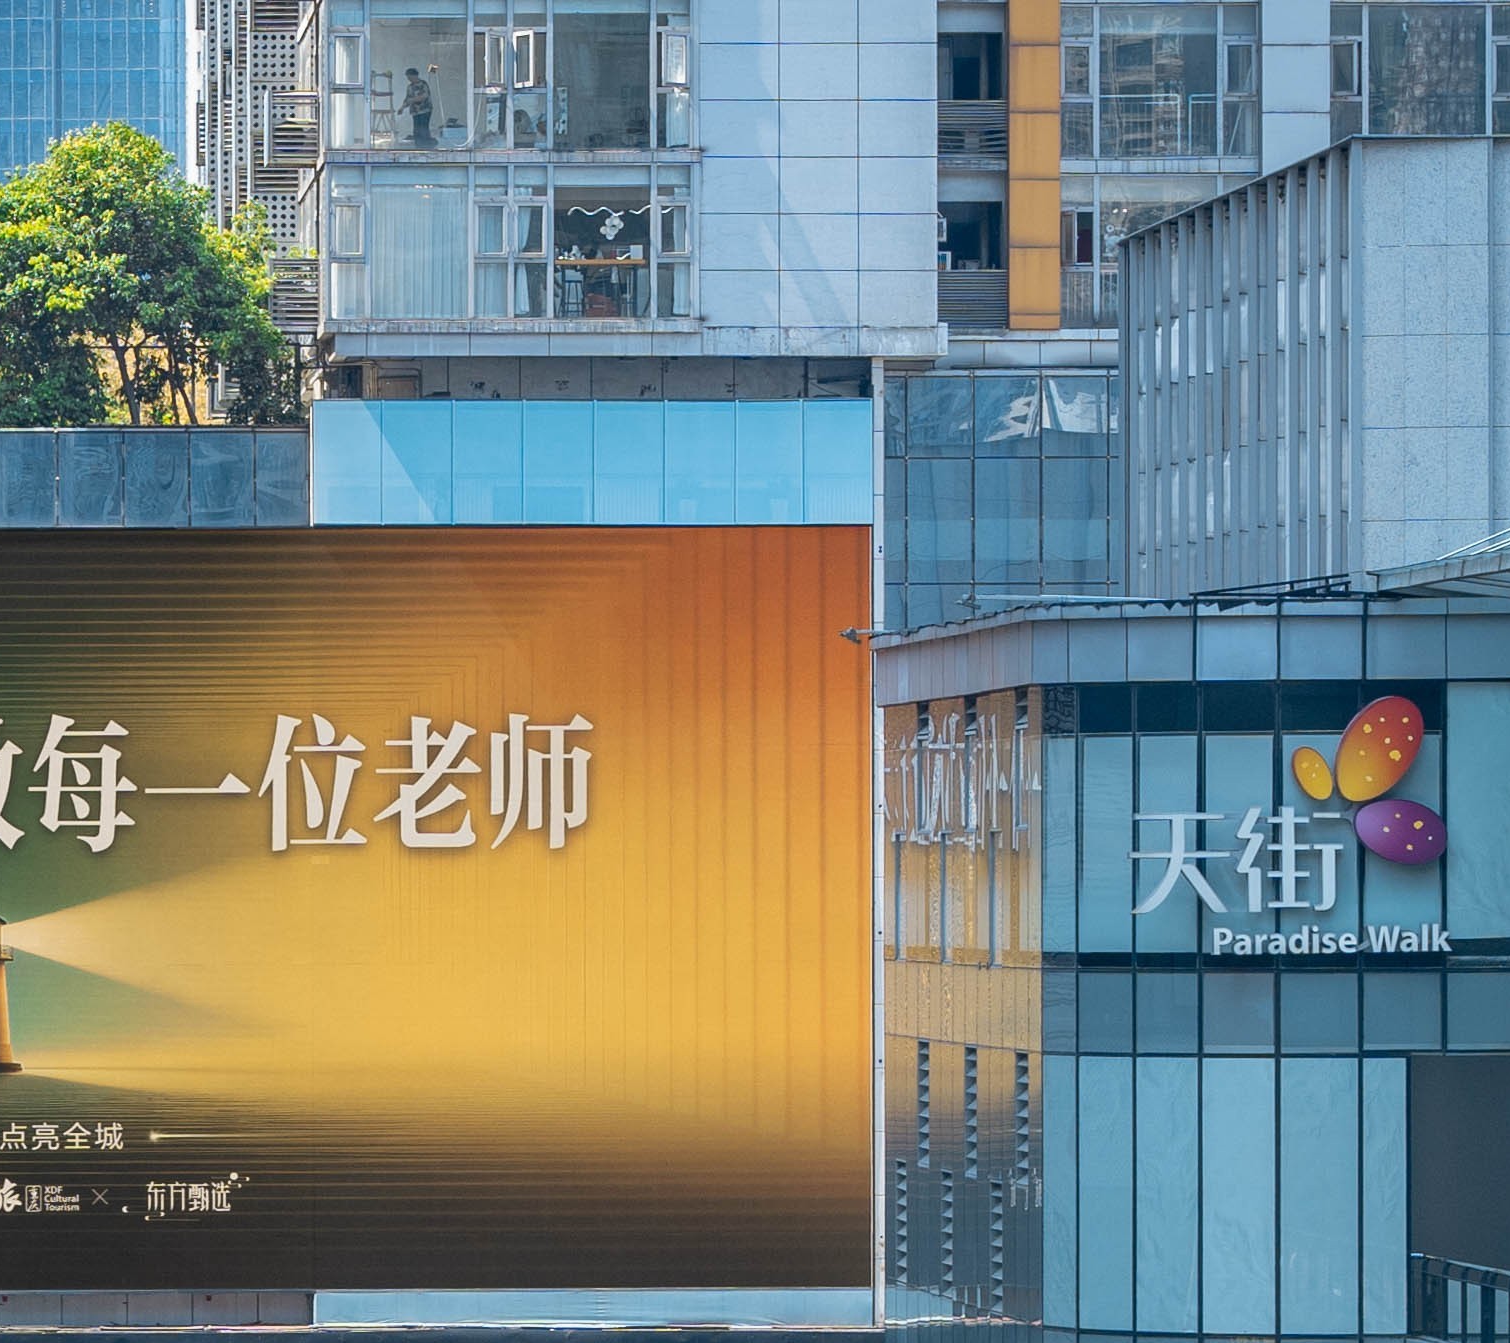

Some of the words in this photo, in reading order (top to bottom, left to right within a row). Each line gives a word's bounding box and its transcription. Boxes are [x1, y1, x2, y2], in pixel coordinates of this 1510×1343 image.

[1129, 806, 1344, 914] 天街
[1212, 925, 1358, 955] Paradise
[1365, 923, 1453, 953] Walk
[0, 1122, 125, 1152] 点亮全城
[44, 1186, 63, 1195] XDF
[44, 1193, 80, 1203] Cultural
[145, 1181, 231, 1213] 东方甄选
[44, 1203, 80, 1212] Tourism
